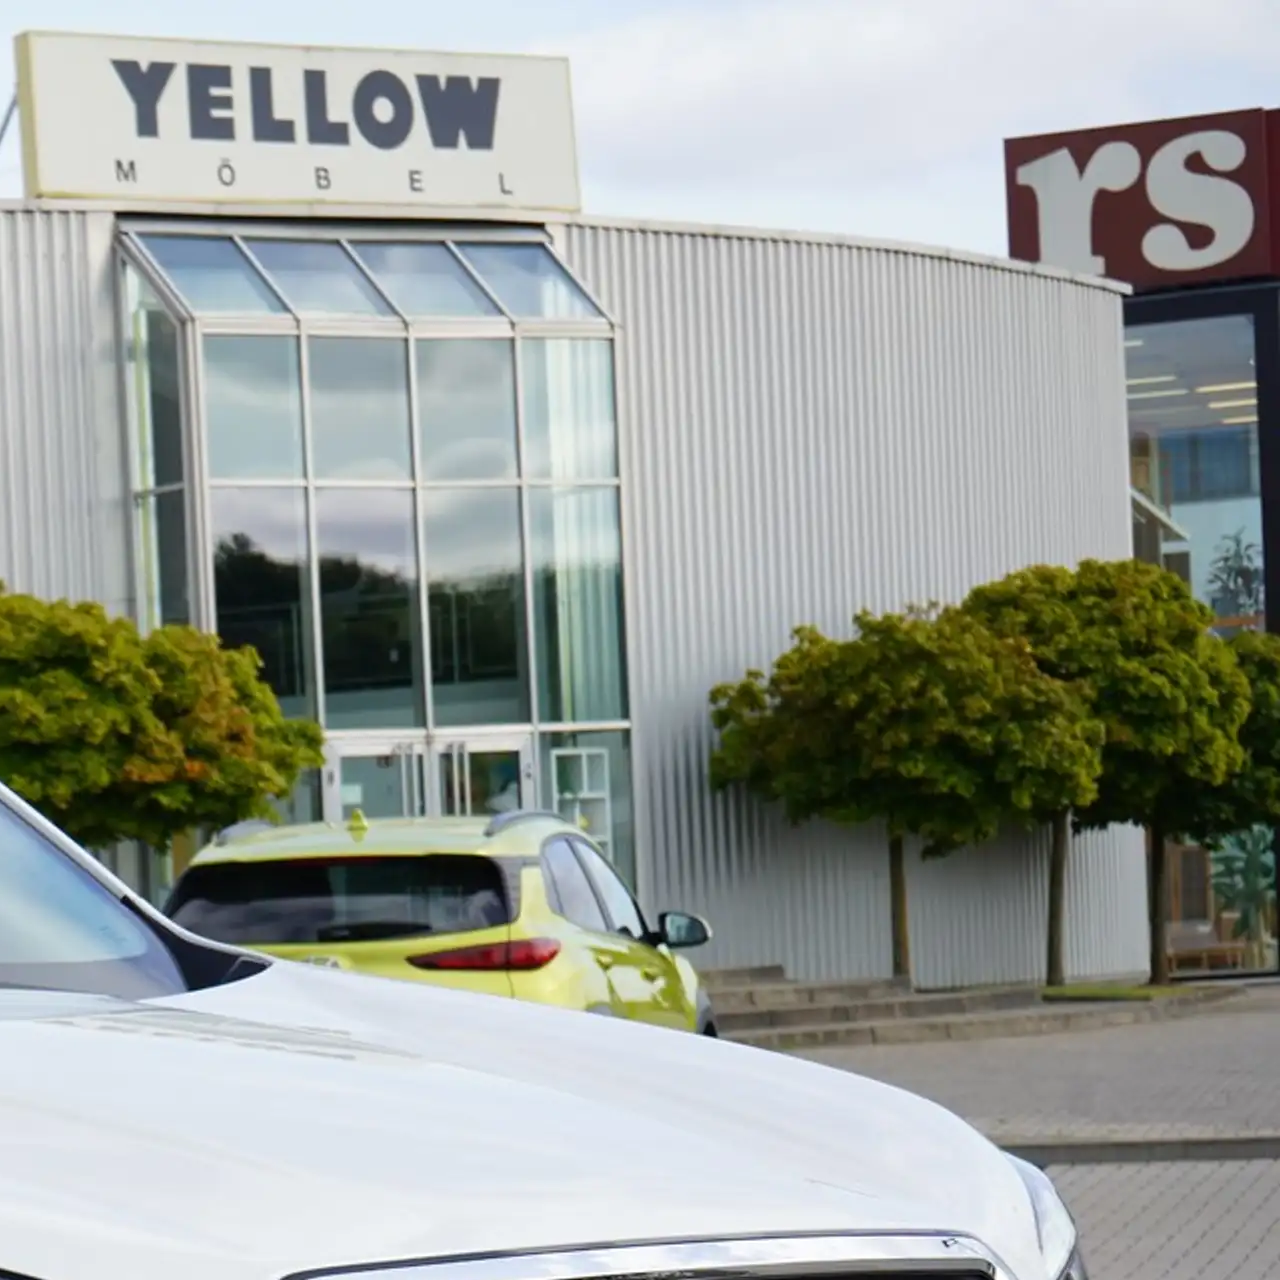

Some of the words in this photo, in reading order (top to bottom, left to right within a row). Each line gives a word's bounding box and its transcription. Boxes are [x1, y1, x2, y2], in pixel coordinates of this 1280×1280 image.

[111, 59, 501, 150] YELLOW
[114, 158, 513, 195] MÖBEL
[1016, 130, 1255, 275] rs
